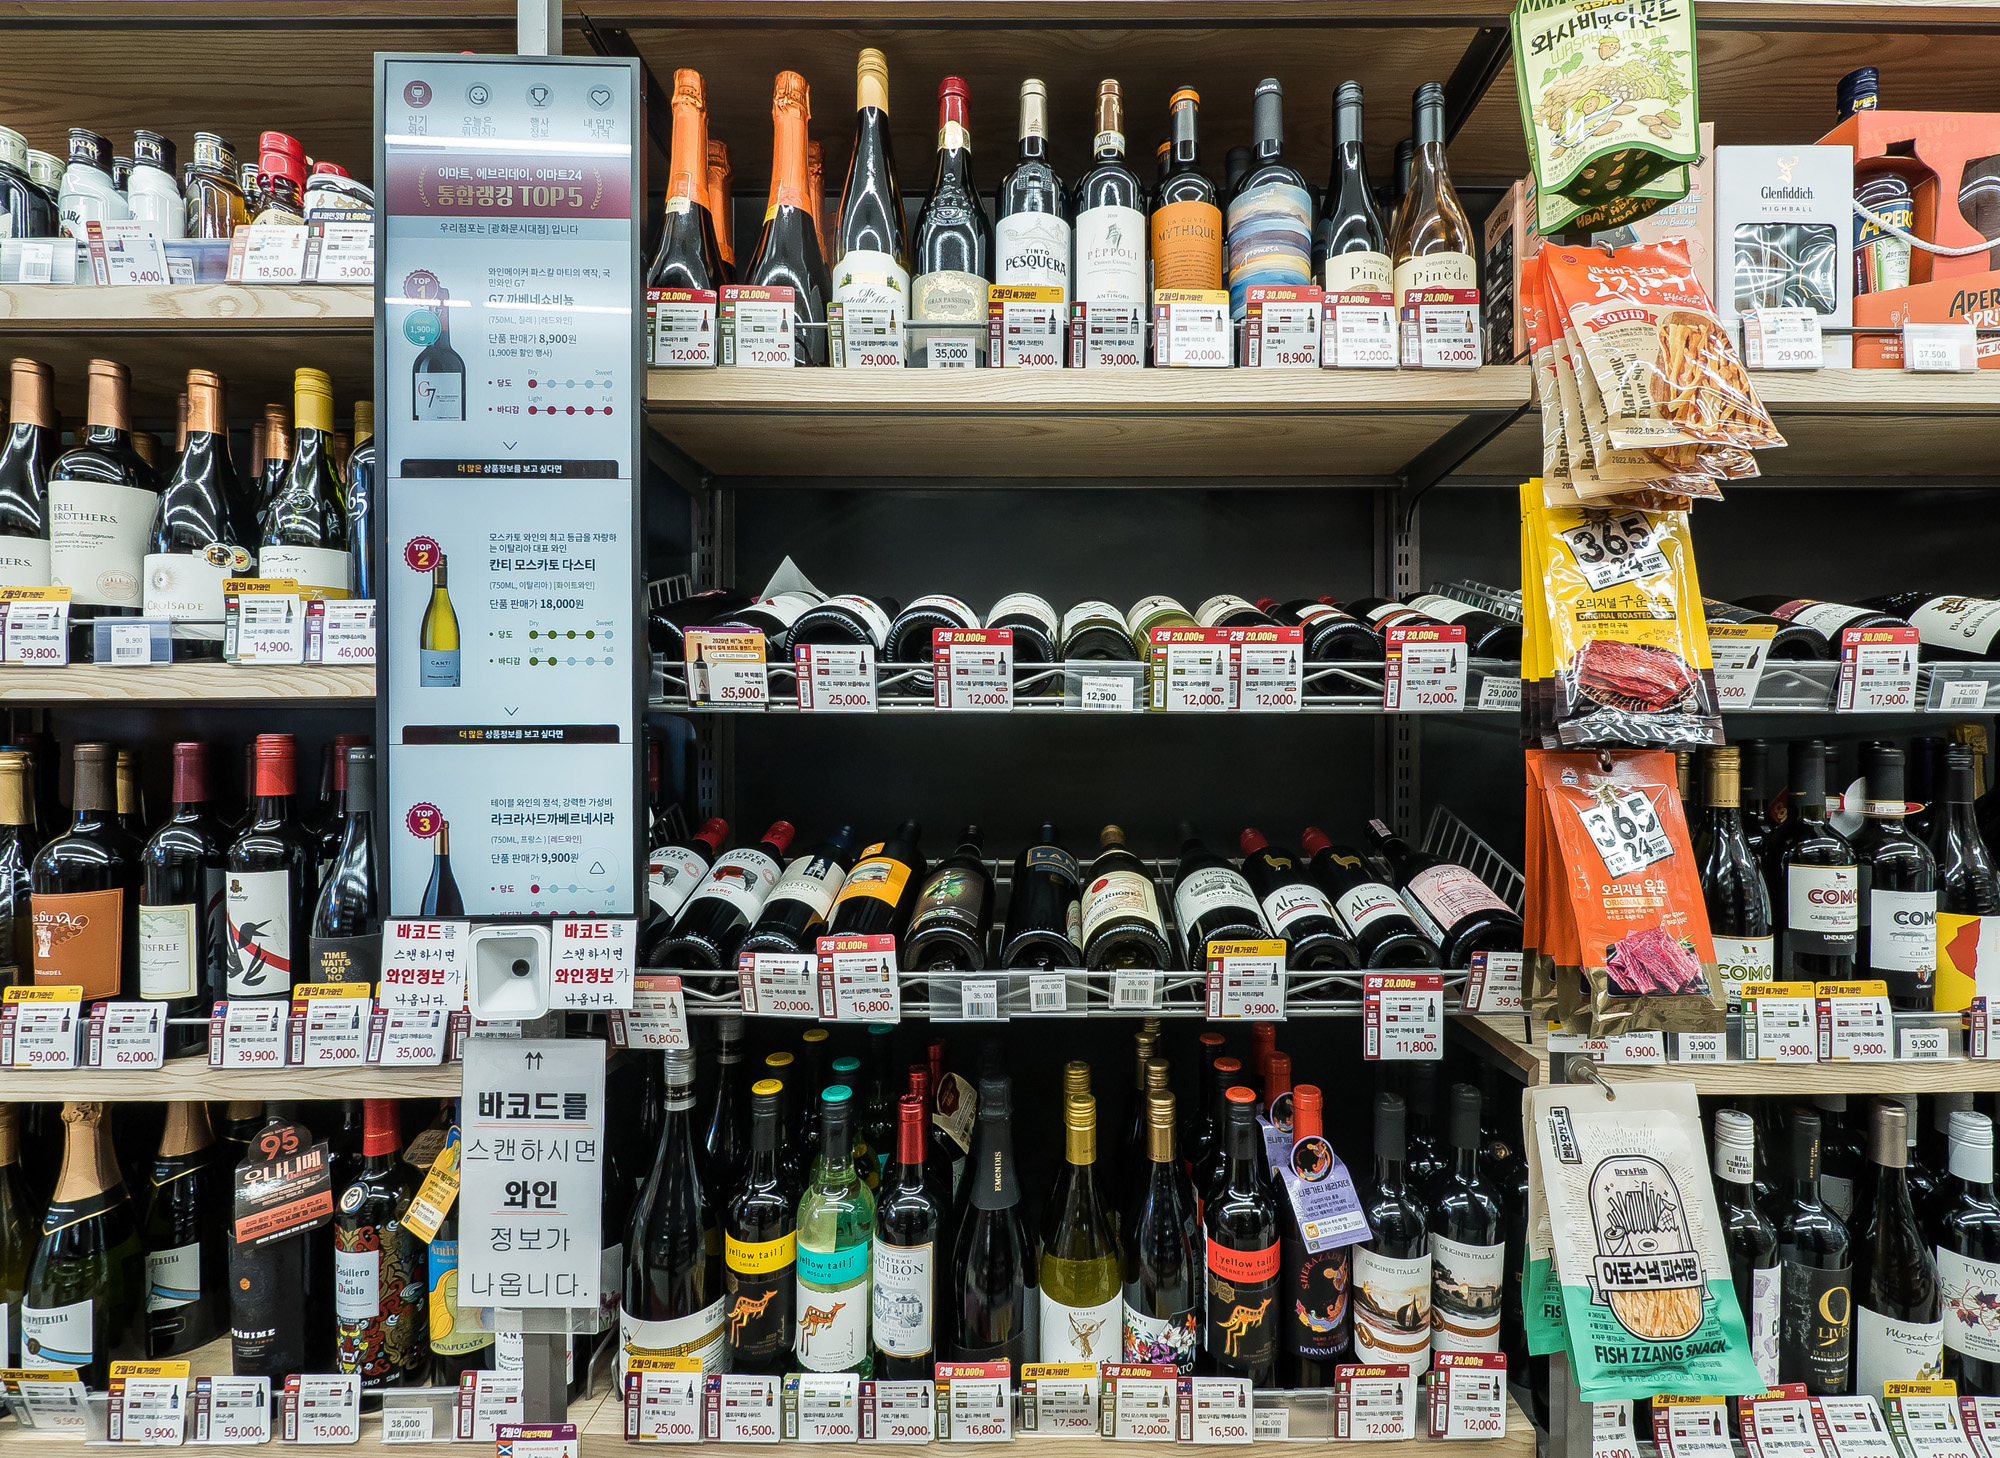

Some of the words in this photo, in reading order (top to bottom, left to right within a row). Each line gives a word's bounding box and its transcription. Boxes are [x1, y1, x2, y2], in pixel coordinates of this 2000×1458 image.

[438, 168, 473, 181] 이마트,
[476, 168, 533, 181] 에브리데이,
[536, 169, 582, 181] 이마트24
[437, 186, 513, 206] 통합랭킹
[1761, 186, 1814, 200] Glenfiddich
[439, 223, 485, 234] 우리점포는
[488, 223, 549, 235] [광화문시대점]
[551, 225, 578, 235] 입니다
[1158, 229, 1216, 242] MYTHIQUE
[1087, 244, 1137, 261] PÈPPOLI
[1005, 255, 1066, 276] PESQUERA
[488, 267, 528, 277] 와인메이커
[530, 268, 556, 278] 파스칼
[558, 268, 580, 278] 마티의
[582, 268, 600, 279] 역작,
[602, 269, 611, 278] 국
[1413, 267, 1469, 286] Pinède
[726, 289, 738, 298] 2병
[740, 290, 770, 299] 20,000원
[1409, 292, 1422, 303] 2병
[1424, 293, 1454, 303] 20,000원
[1597, 310, 1644, 325] SQUID
[488, 333, 506, 345] 단품
[509, 333, 536, 345] 판매가
[538, 333, 577, 346] 8,900원
[935, 348, 967, 359] 35,000
[497, 378, 512, 388] 당도
[497, 404, 519, 415] 바디감
[457, 464, 465, 472] 더
[467, 464, 481, 472] 많은
[483, 464, 521, 473] 상품정보를
[539, 464, 561, 473] 싶다면
[54, 504, 73, 512] FREI
[53, 513, 118, 523] BROTHERS.
[489, 533, 521, 542] 모스카토
[524, 533, 547, 542] 와인의
[549, 533, 564, 542] 최고
[567, 533, 590, 543] 등급을
[592, 533, 617, 543] 자랑하
[1573, 518, 1650, 563] 365
[489, 544, 497, 553] 는
[499, 544, 530, 553] 이탈리아
[532, 544, 546, 553] 대표
[549, 544, 567, 554] 와인
[417, 552, 429, 566] 2
[489, 558, 511, 572] 칸티
[514, 558, 559, 572] 모스카토
[562, 559, 596, 572] 다스티
[1642, 557, 1660, 565] EVERY
[1647, 562, 1663, 571] TIME!
[226, 582, 246, 591] 2월의
[247, 583, 270, 591] 특가와인
[518, 581, 549, 590] 이탈리아
[1, 590, 20, 599] 2월의
[489, 598, 508, 610] 단품
[511, 598, 538, 610] 판매가
[540, 598, 584, 610] 18,000원
[1576, 597, 1616, 609] 오리지널
[498, 630, 513, 640] 당도
[937, 632, 952, 642] 2병
[954, 632, 986, 642] 20,000원
[1846, 632, 1861, 643] 2병
[1862, 632, 1893, 643] 30,000원
[498, 656, 521, 666] 바디감
[1086, 692, 1117, 702] 12,900
[1488, 688, 1518, 698] 29,000
[490, 797, 514, 807] 테이블
[517, 797, 540, 807] 와인의
[542, 797, 560, 808] 정석,
[563, 797, 587, 807] 강력한
[588, 797, 613, 807] 가성비
[419, 818, 431, 832] 3
[491, 812, 614, 826] 라크라사드까베르네시라
[548, 835, 582, 845] [레드와인]
[510, 852, 539, 864] 판매가
[541, 852, 579, 865] 9,900원
[1602, 884, 1643, 895] 오리지널
[1644, 879, 1667, 894] 육포
[1605, 898, 1641, 906] ORIGINAL
[397, 924, 457, 940] 바코드를
[564, 923, 624, 939] 바코드를
[328, 974, 343, 982] NO
[385, 968, 461, 985] 와인정보가
[555, 968, 630, 984] 와인정보가
[1718, 964, 1771, 980] COMO
[8, 989, 27, 999] 2월의
[29, 991, 54, 999] 특가와인
[565, 992, 618, 1007] 나옵니다.
[396, 994, 448, 1008] 나옵니다.
[1689, 1040, 1716, 1051] 9,900
[1911, 1039, 1938, 1050] 9,900
[479, 1091, 588, 1120] 바코드를
[260, 1133, 299, 1160] 95
[466, 1139, 596, 1163] 스캔하시면
[243, 1150, 322, 1186] 우나니메
[503, 1181, 557, 1210] 와인
[490, 1228, 571, 1252] 정보가
[728, 1248, 755, 1259] yellow
[758, 1248, 777, 1259] tail
[1220, 1252, 1252, 1269] yellow
[806, 1270, 831, 1278] MOSCATO
[1602, 1261, 1660, 1285] 어포스낵
[1963, 1263, 1990, 1277] TWO
[338, 1283, 364, 1294] Diablo
[471, 1272, 588, 1298] 나옵니다.
[1594, 1346, 1628, 1363] FISH
[1632, 1345, 1683, 1363] ZZANG
[1685, 1340, 1726, 1358] SNACK
[391, 1419, 420, 1429] 38,000
